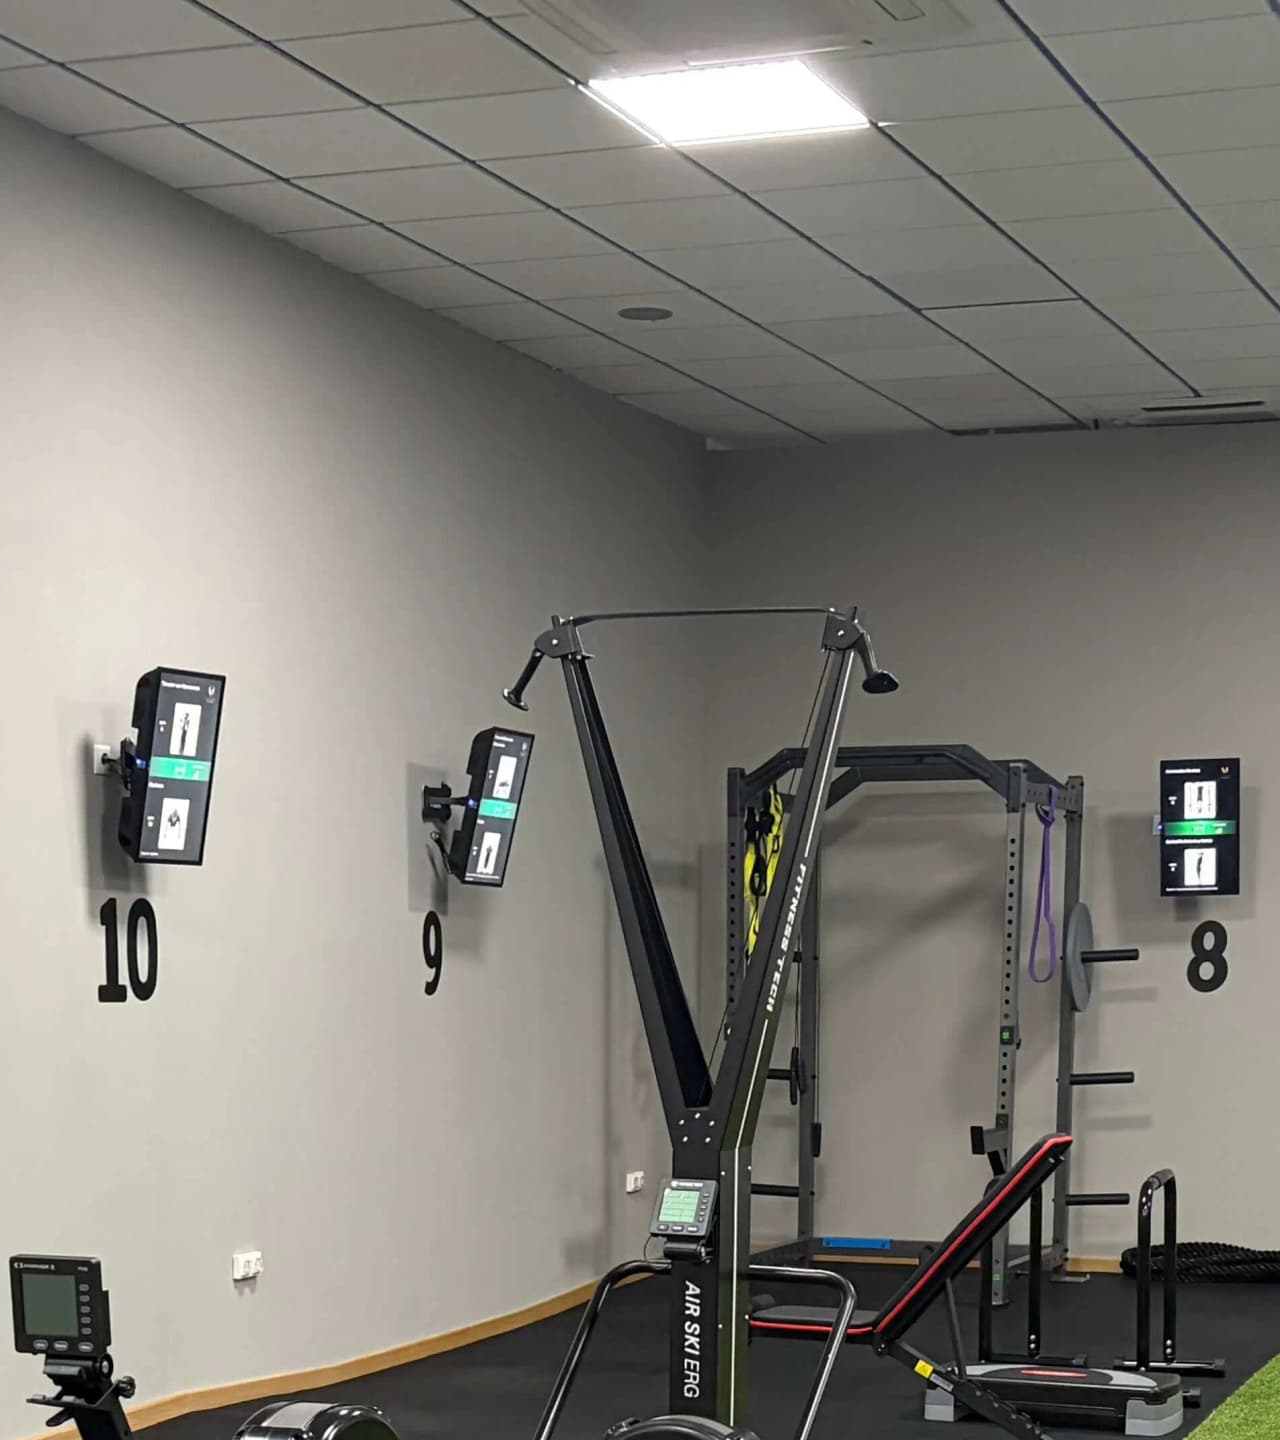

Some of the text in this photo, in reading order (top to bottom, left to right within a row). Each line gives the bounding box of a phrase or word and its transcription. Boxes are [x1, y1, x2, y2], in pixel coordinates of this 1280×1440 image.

[98, 897, 158, 1003] 10
[423, 910, 442, 996] 9
[766, 863, 807, 1012] FITNESS TECH
[1187, 920, 1228, 993] 8
[684, 1280, 701, 1398] AIR SKI ERG
